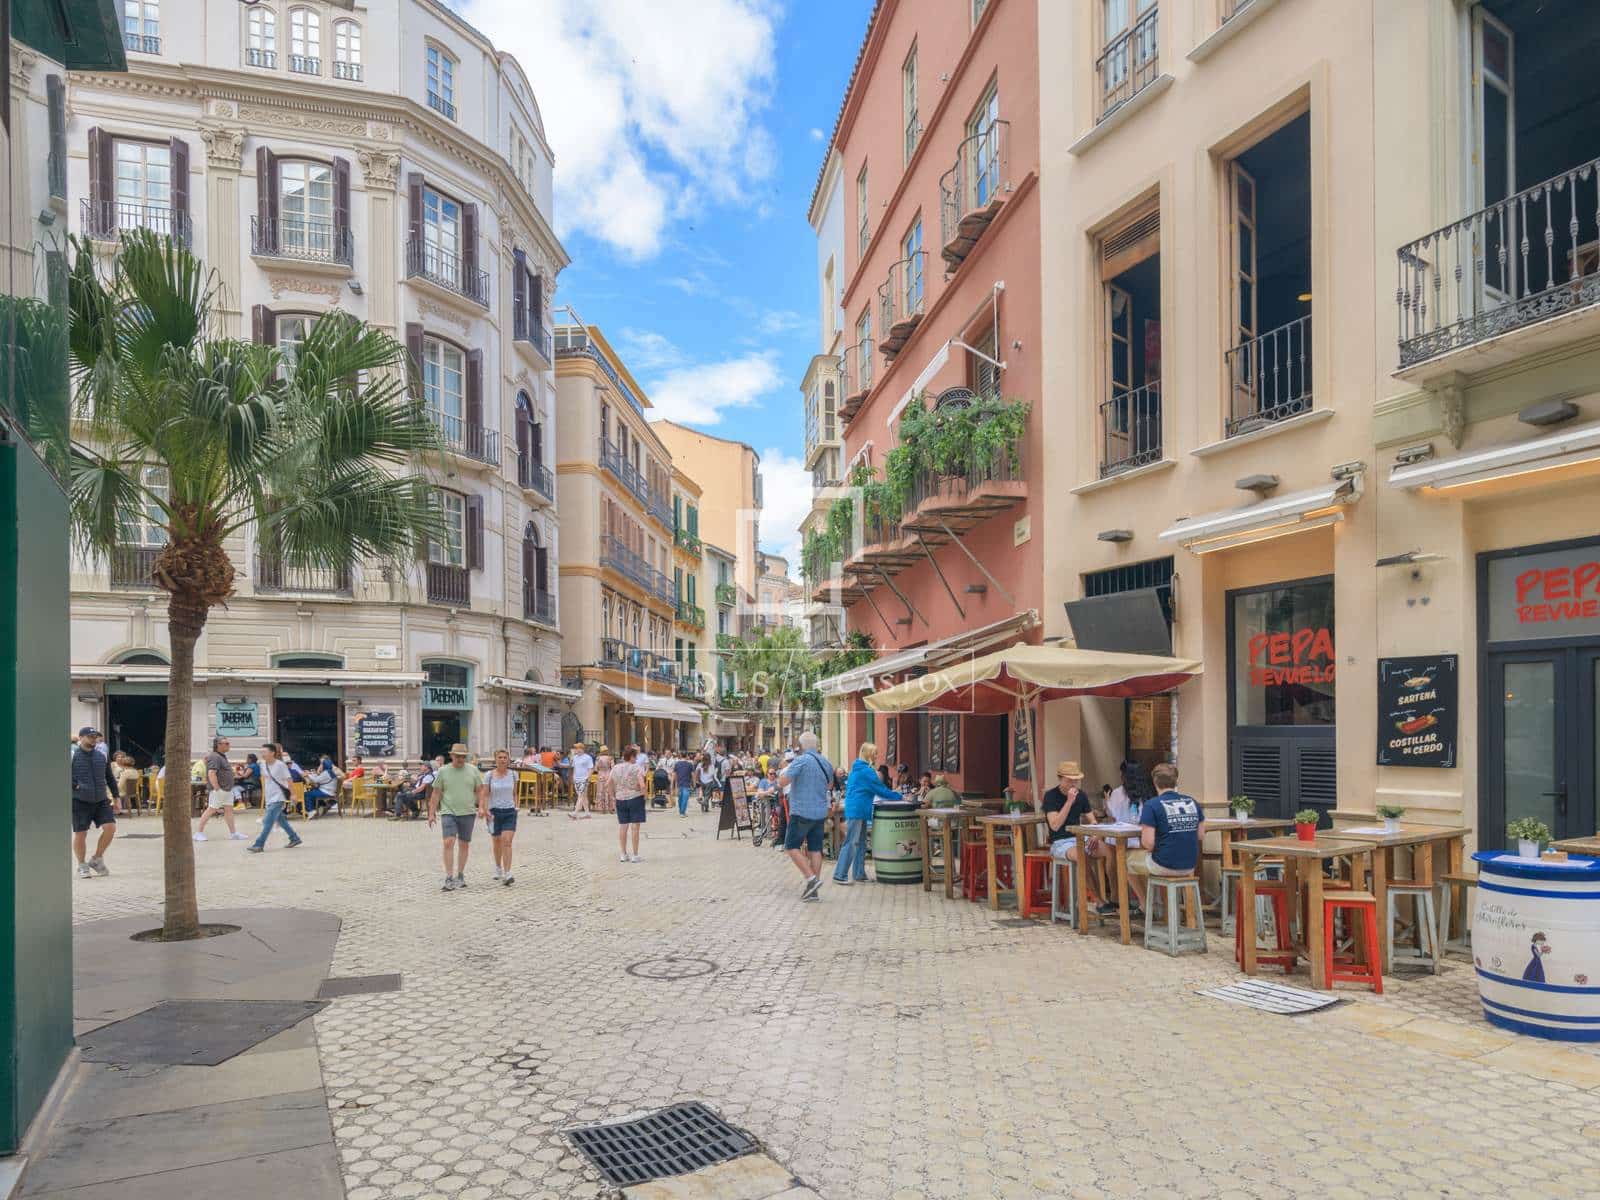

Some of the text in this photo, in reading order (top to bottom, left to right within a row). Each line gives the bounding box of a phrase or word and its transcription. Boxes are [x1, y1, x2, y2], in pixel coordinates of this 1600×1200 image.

[1515, 561, 1600, 604] PEP
[1248, 627, 1336, 665] PEPA
[429, 688, 465, 704] TABERNA
[220, 712, 254, 724] TABERNA
[1390, 733, 1437, 748] COSTILLAR
[1413, 742, 1443, 755] CERDO
